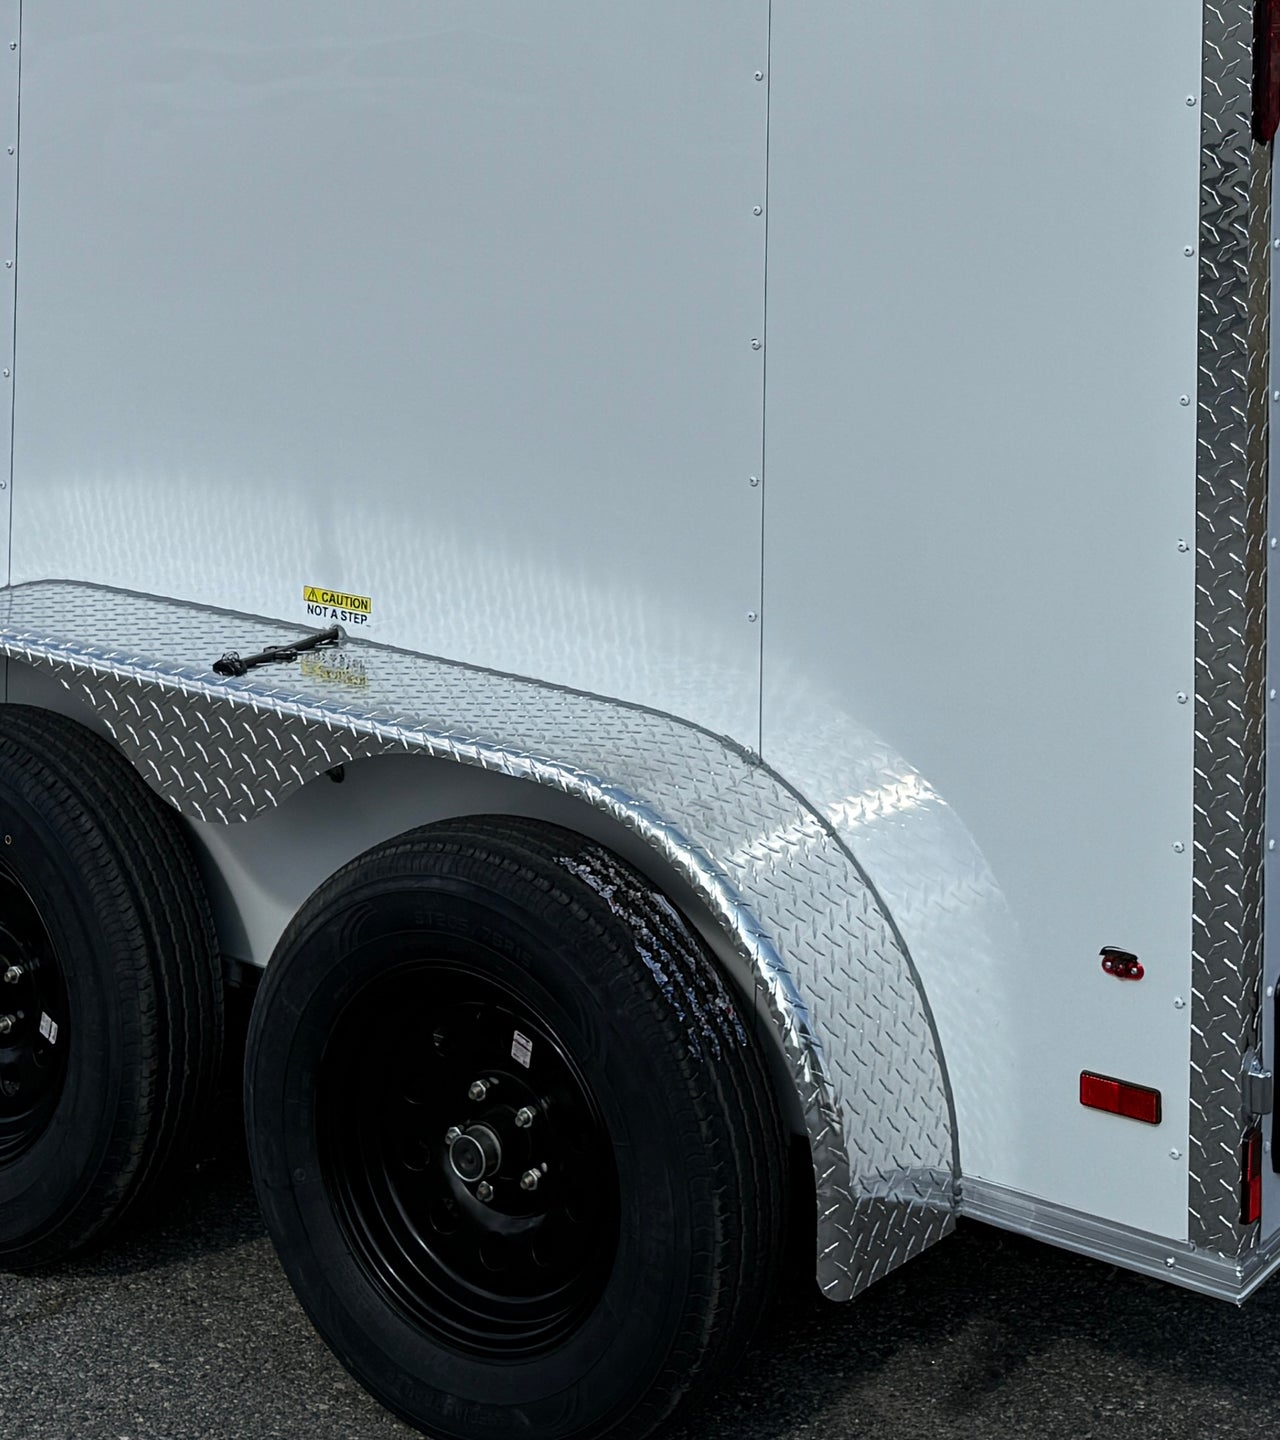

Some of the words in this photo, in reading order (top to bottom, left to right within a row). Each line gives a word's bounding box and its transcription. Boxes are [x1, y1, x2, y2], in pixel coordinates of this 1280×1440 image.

[321, 592, 368, 610] CAUTION
[307, 604, 329, 618] NOT
[330, 609, 338, 620] A
[340, 611, 368, 625] STEP
